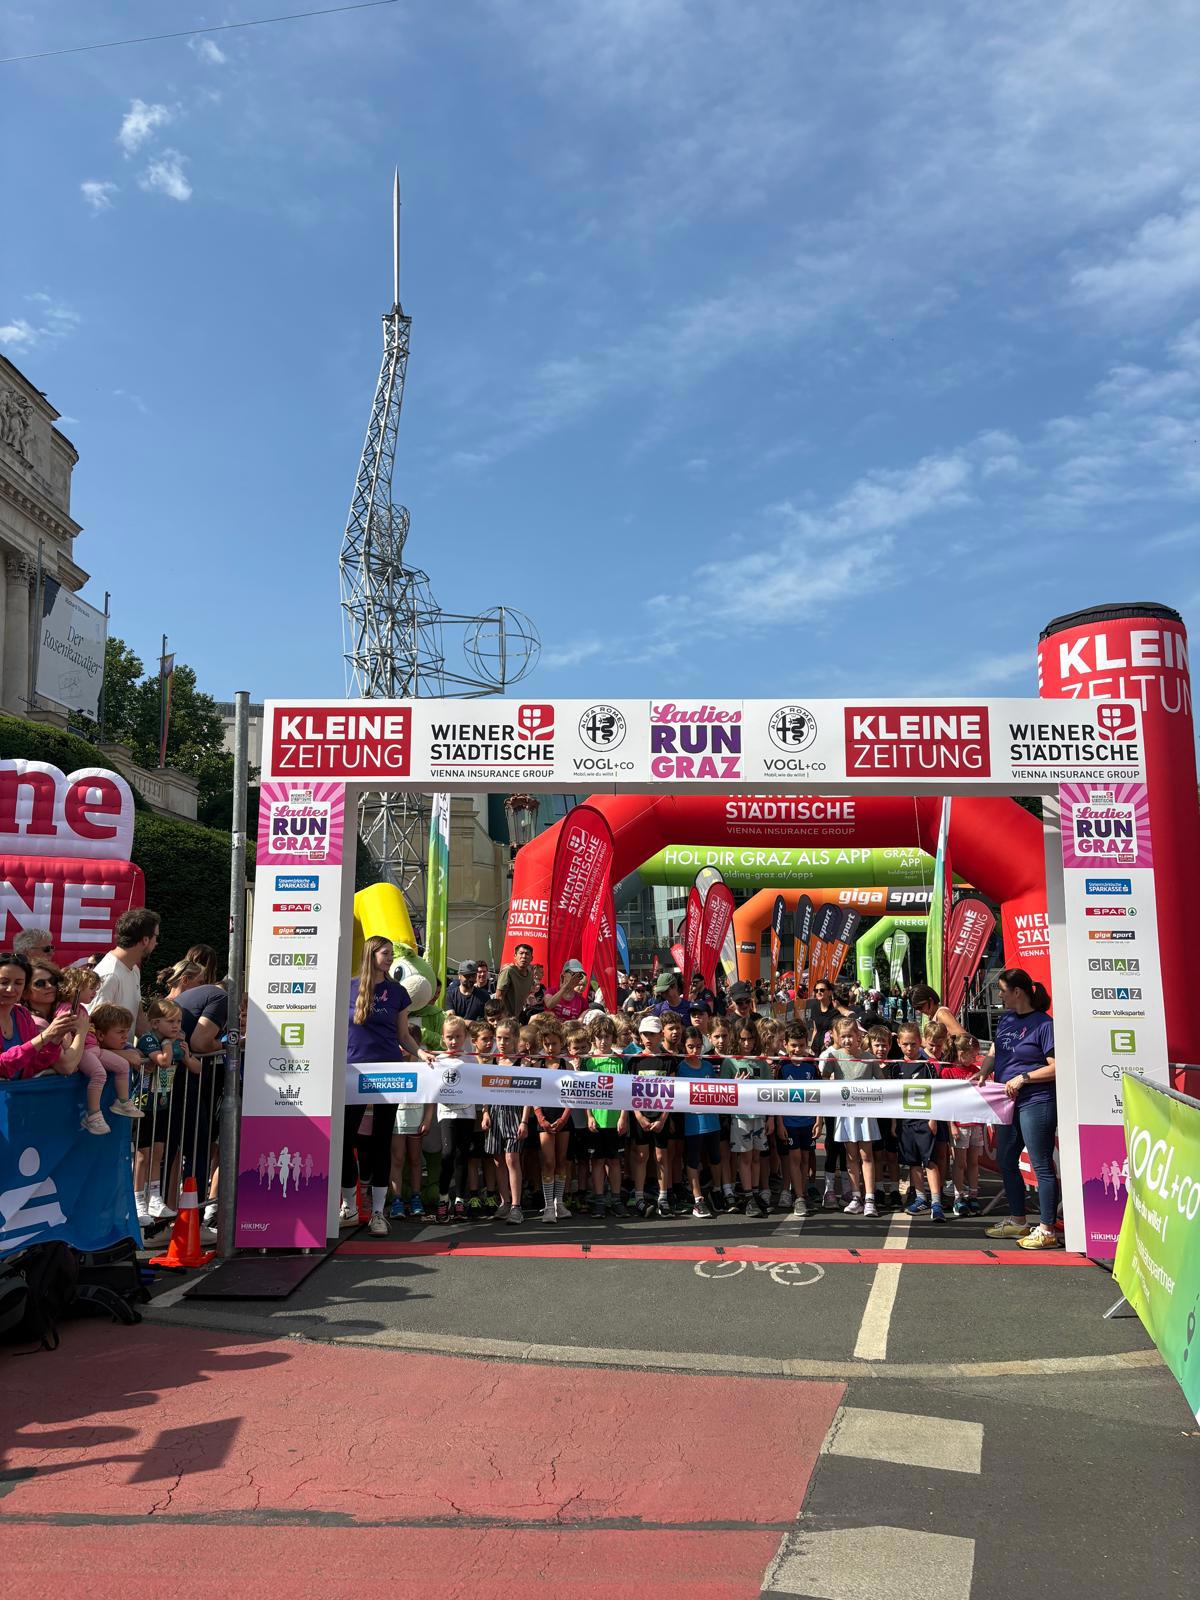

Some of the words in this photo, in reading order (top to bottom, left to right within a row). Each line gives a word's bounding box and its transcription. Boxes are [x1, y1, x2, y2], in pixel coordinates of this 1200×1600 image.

[67, 625, 84, 647] Der
[43, 629, 102, 678] Rosenkavalier
[1059, 630, 1189, 679] KLEIN
[581, 710, 596, 729] ALFA
[600, 707, 624, 729] ROMEO
[650, 703, 742, 724] Ladies
[770, 710, 786, 730] ALFA
[789, 707, 815, 730] ROMEO
[281, 715, 404, 740] KLEINE
[431, 724, 515, 740] WIENER
[853, 715, 981, 740] KLEINE
[1009, 724, 1095, 741] WIENER
[651, 725, 741, 754] RUN
[279, 744, 403, 768] ZEITUNG
[430, 744, 554, 760] STÄDTISCHE
[854, 744, 982, 769] ZEITUNG
[1010, 744, 1139, 761] STÄDTISCHE
[523, 770, 554, 778] GROUP
[651, 756, 741, 778] GRAZ
[1012, 770, 1047, 778] VIENNA
[1050, 770, 1104, 778] INSURANCE
[1107, 770, 1140, 779] GROUP
[273, 805, 328, 817] Ladies
[725, 802, 856, 819] STÄDTISCHE
[1076, 807, 1132, 819] Ladies
[273, 818, 327, 835] RUN
[726, 827, 762, 835] VIENNA
[1076, 820, 1133, 837] RUN
[272, 837, 326, 850] GRAZ
[1078, 839, 1134, 853] GRAZ
[665, 850, 701, 865] HOL
[706, 851, 735, 865] DIR
[740, 851, 792, 865] GRAZ
[797, 851, 830, 865] ALS
[835, 849, 871, 865] APP
[883, 849, 914, 858] GRAZ
[900, 858, 920, 868] APP
[558, 854, 583, 909] WIENER
[568, 835, 600, 915] STÄDTISCHE
[722, 870, 814, 880] olding-graz.at/apps
[838, 888, 883, 905] giga
[889, 892, 933, 906] spor
[511, 899, 549, 912] WIENE
[509, 912, 548, 926] STÄDTI
[801, 905, 812, 941] sport
[819, 909, 833, 939] sport
[1014, 912, 1050, 929] WIE
[840, 913, 855, 942] sport
[953, 909, 977, 955] KLEINE
[964, 913, 988, 958] ZEITUNG
[270, 954, 316, 965] GRAZ
[831, 944, 843, 968] giga
[1089, 960, 1138, 970] GRAZ
[269, 983, 315, 993] GRAZ
[1092, 989, 1141, 998] GRAZ
[286, 1003, 317, 1011] Volkspartei
[489, 1077, 510, 1086] giga
[512, 1079, 539, 1087] sport
[561, 1080, 597, 1089] WIENER
[692, 1084, 736, 1093] KLEINE
[560, 1089, 614, 1098] STÄDTISCHE
[632, 1083, 675, 1098] RUN
[692, 1093, 736, 1104] ZEITUNG
[758, 1089, 819, 1102] GRAZ
[631, 1098, 675, 1110] GRAZ
